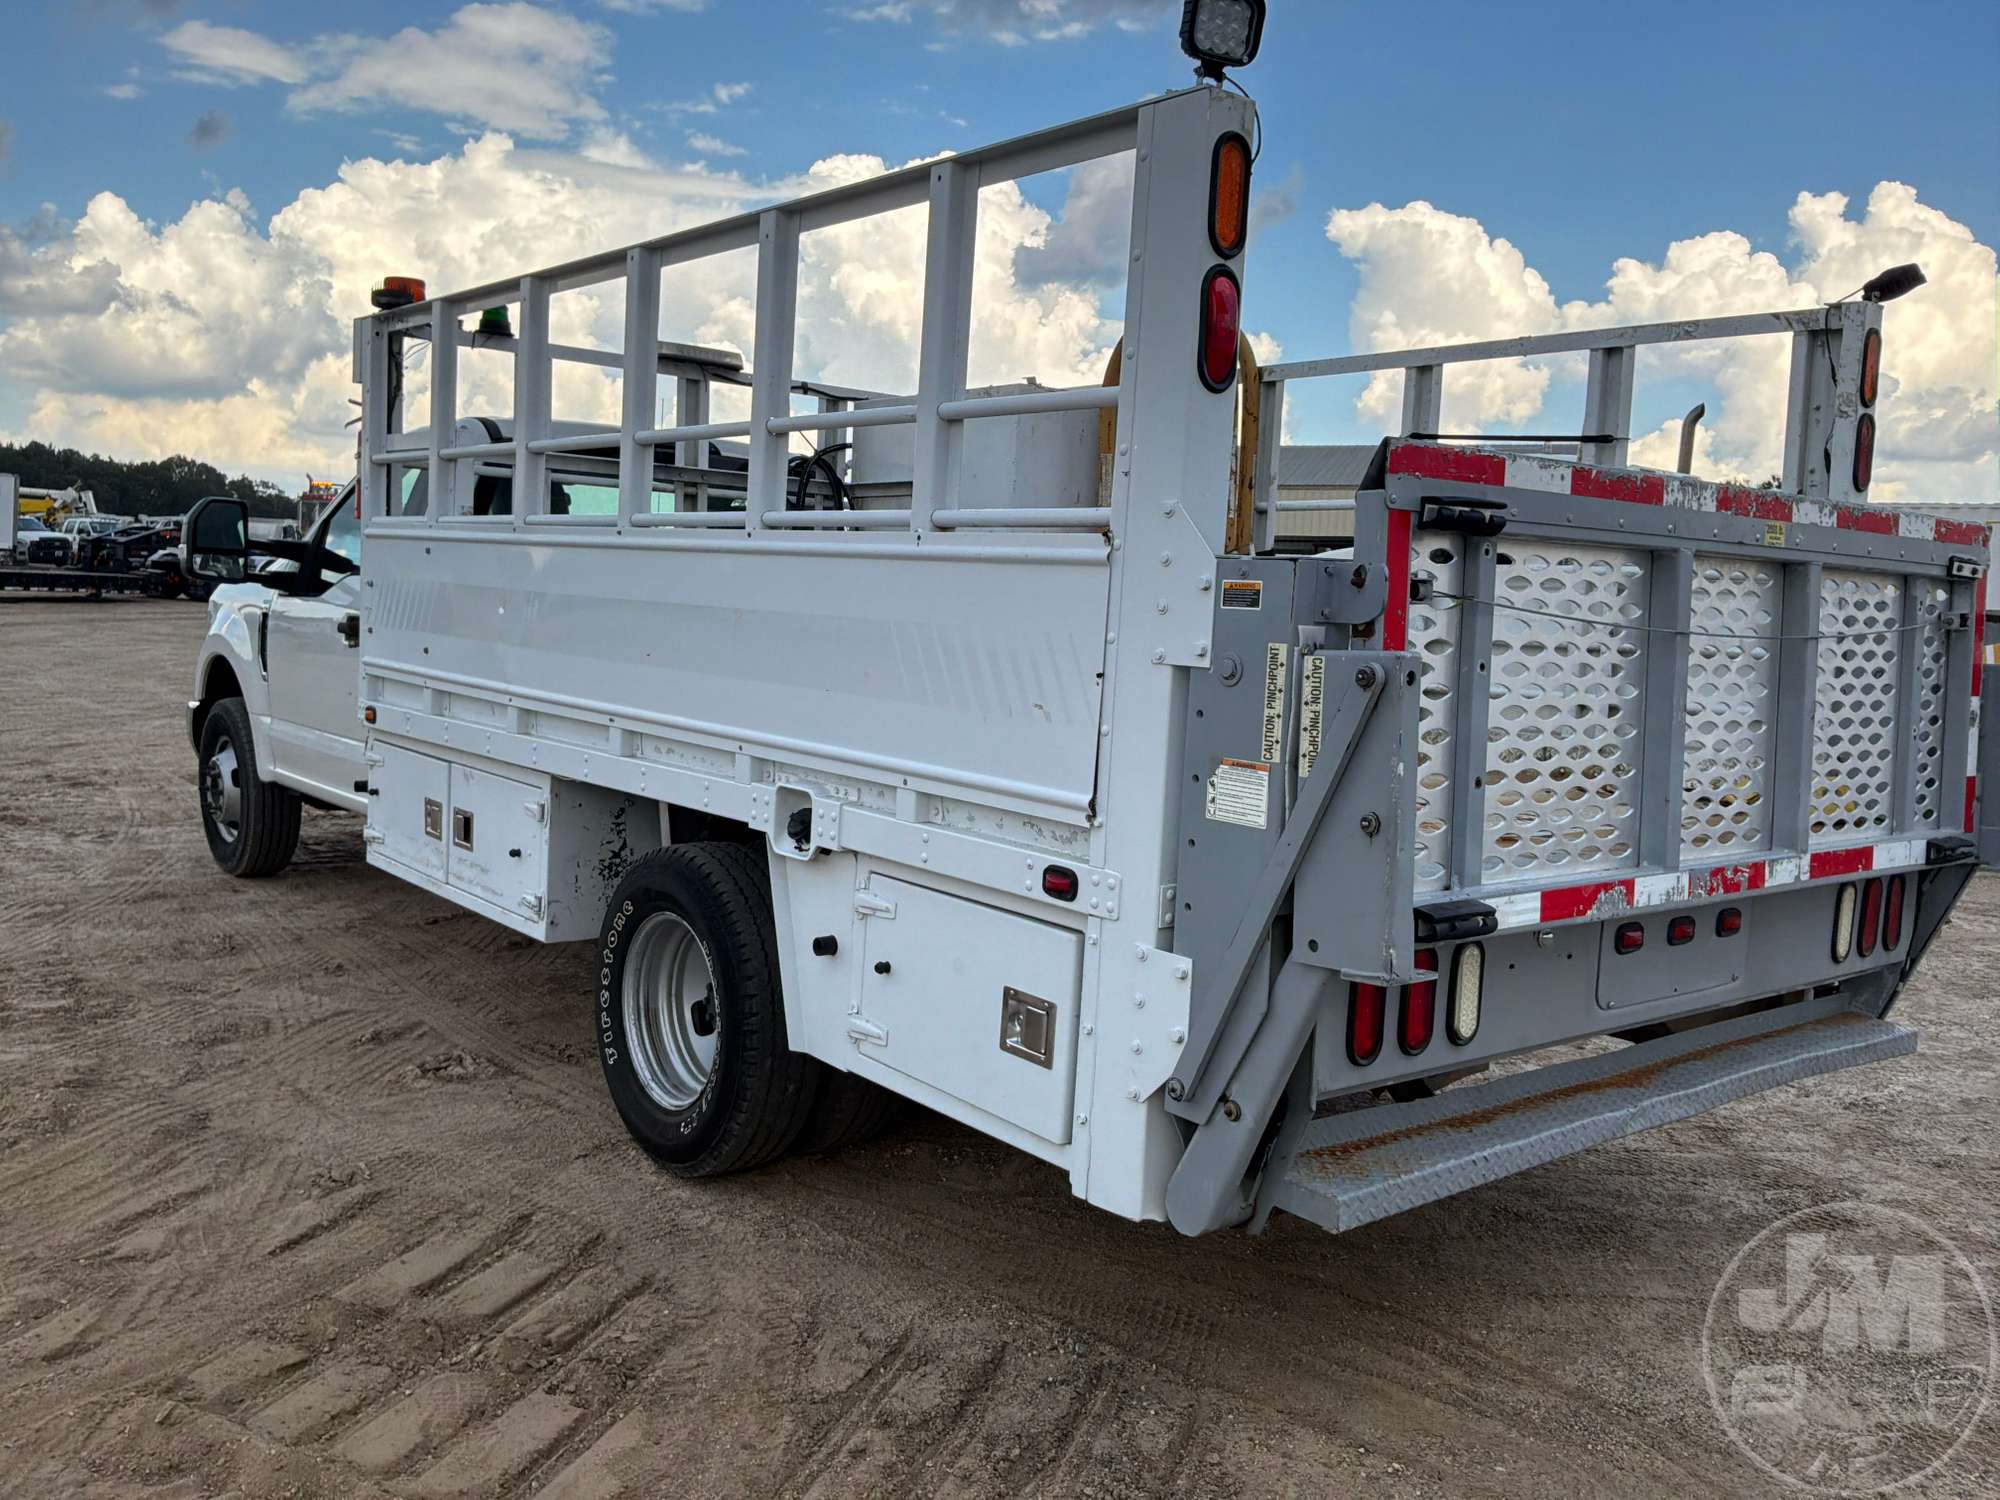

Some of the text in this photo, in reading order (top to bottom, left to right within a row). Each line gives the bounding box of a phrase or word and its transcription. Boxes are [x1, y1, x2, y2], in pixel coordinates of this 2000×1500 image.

[1263, 646, 1280, 761] CAUTION: PINCHPOINT
[1307, 657, 1323, 773] CAUTION: PINCHPOIN
